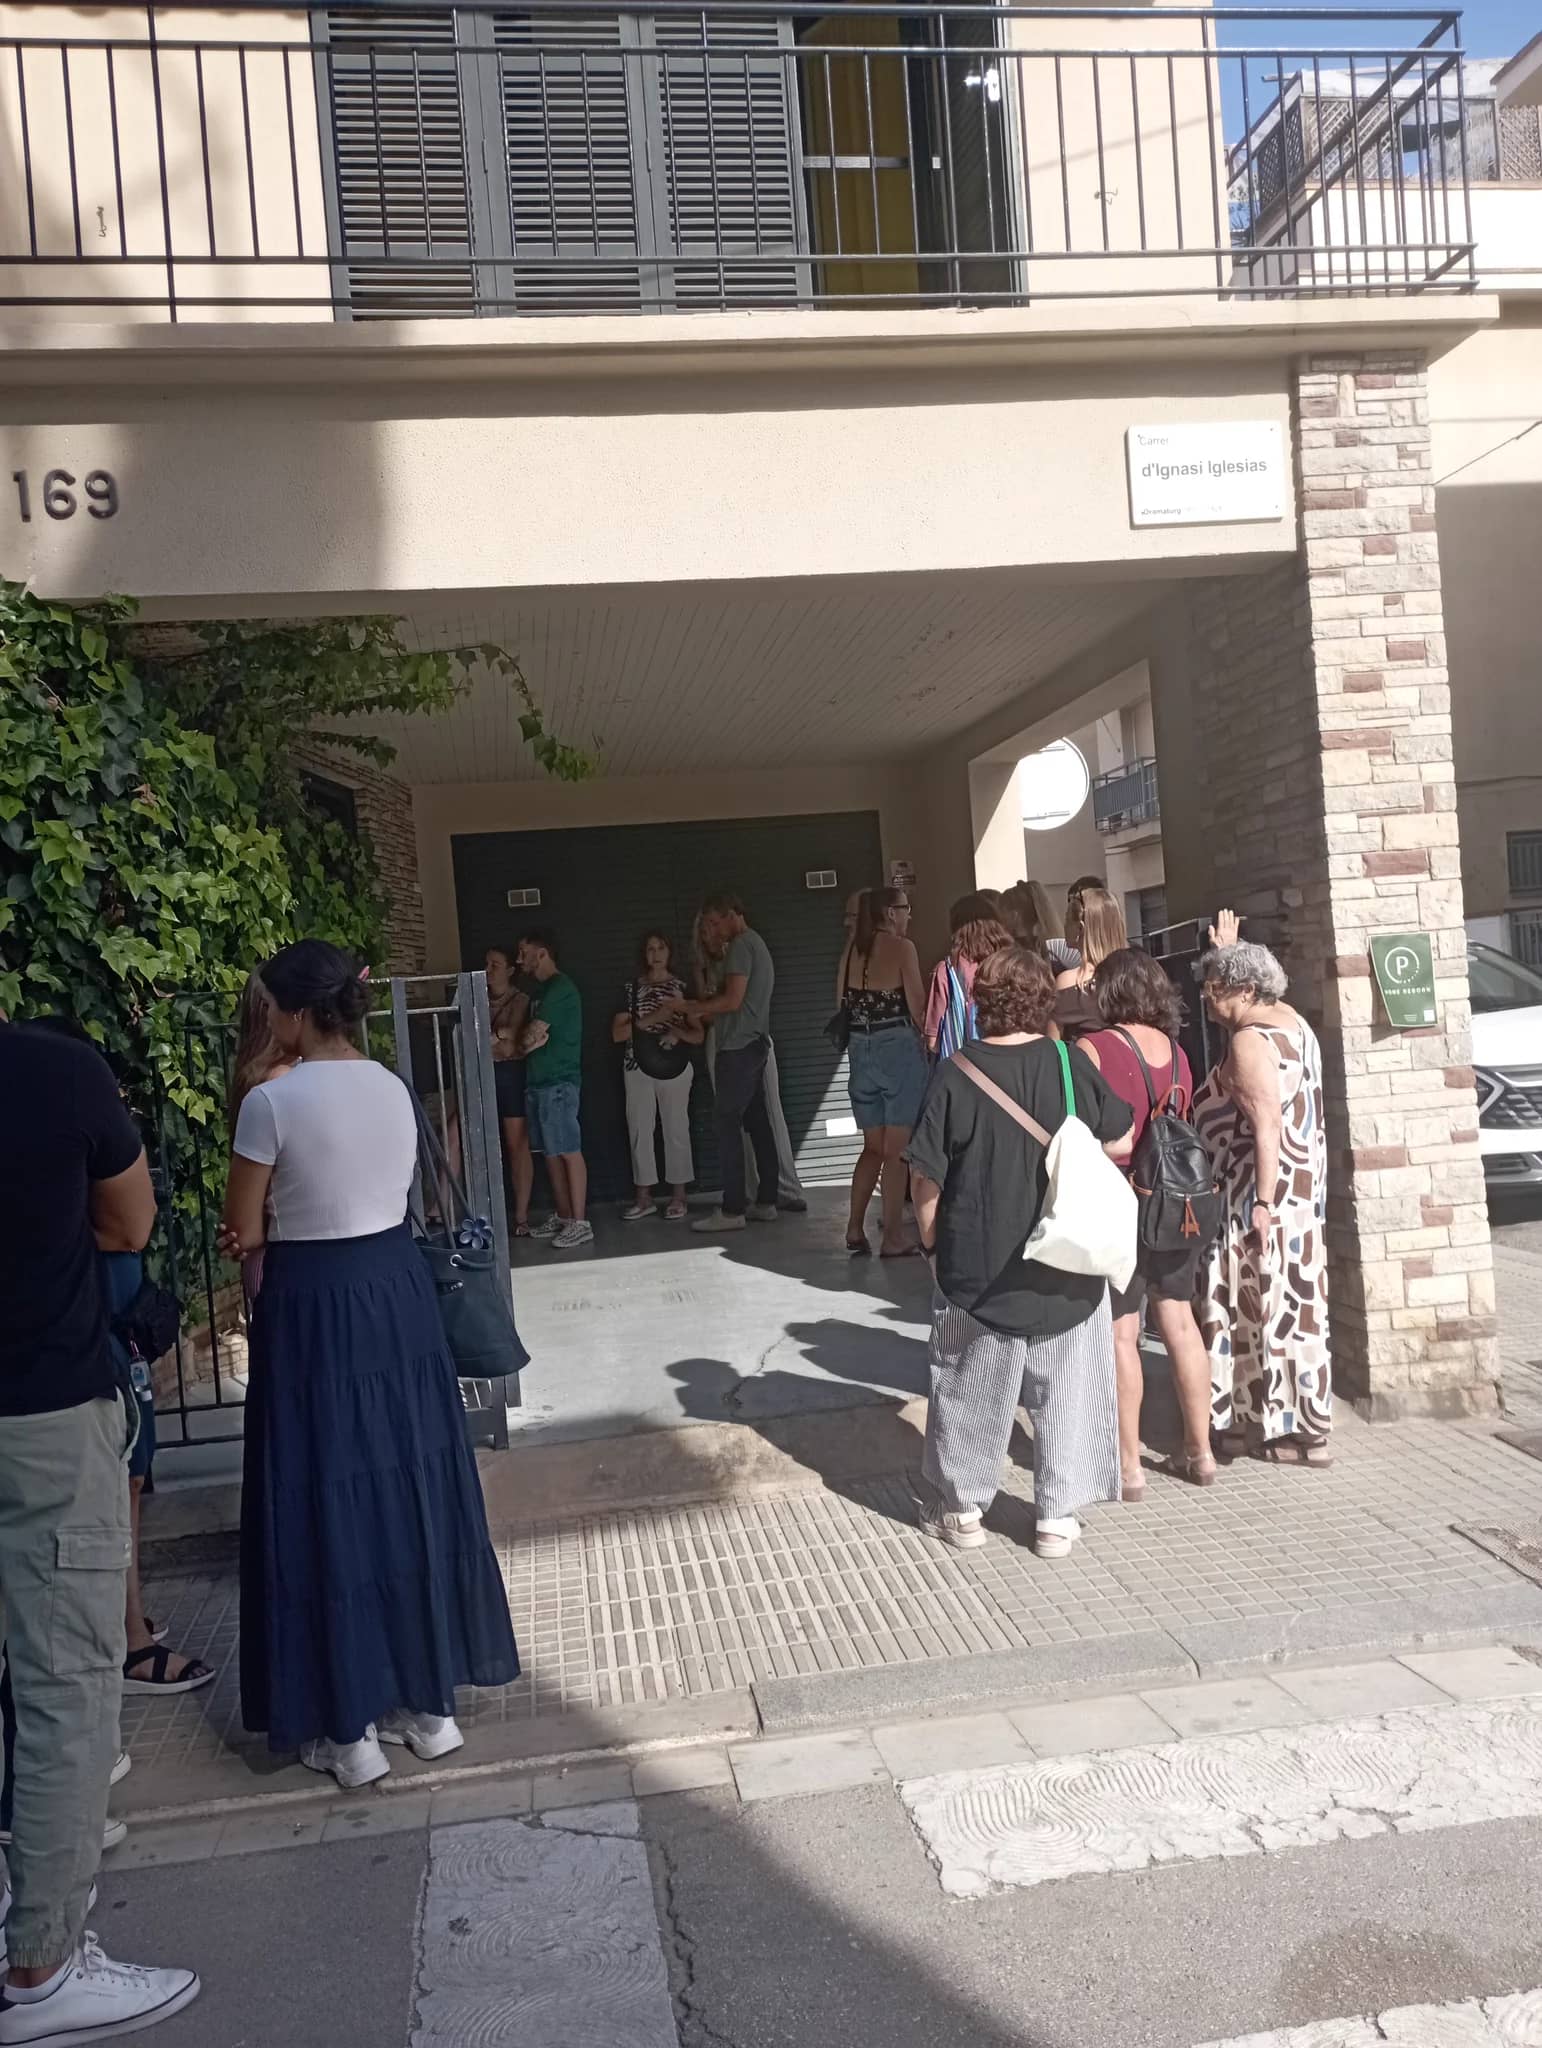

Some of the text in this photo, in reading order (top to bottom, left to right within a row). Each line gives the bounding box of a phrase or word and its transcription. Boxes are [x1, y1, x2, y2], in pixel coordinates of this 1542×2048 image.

[1142, 459, 1267, 480] d'Ignasi Iglesias
[13, 469, 119, 523] 169
[1396, 956, 1409, 976] P
